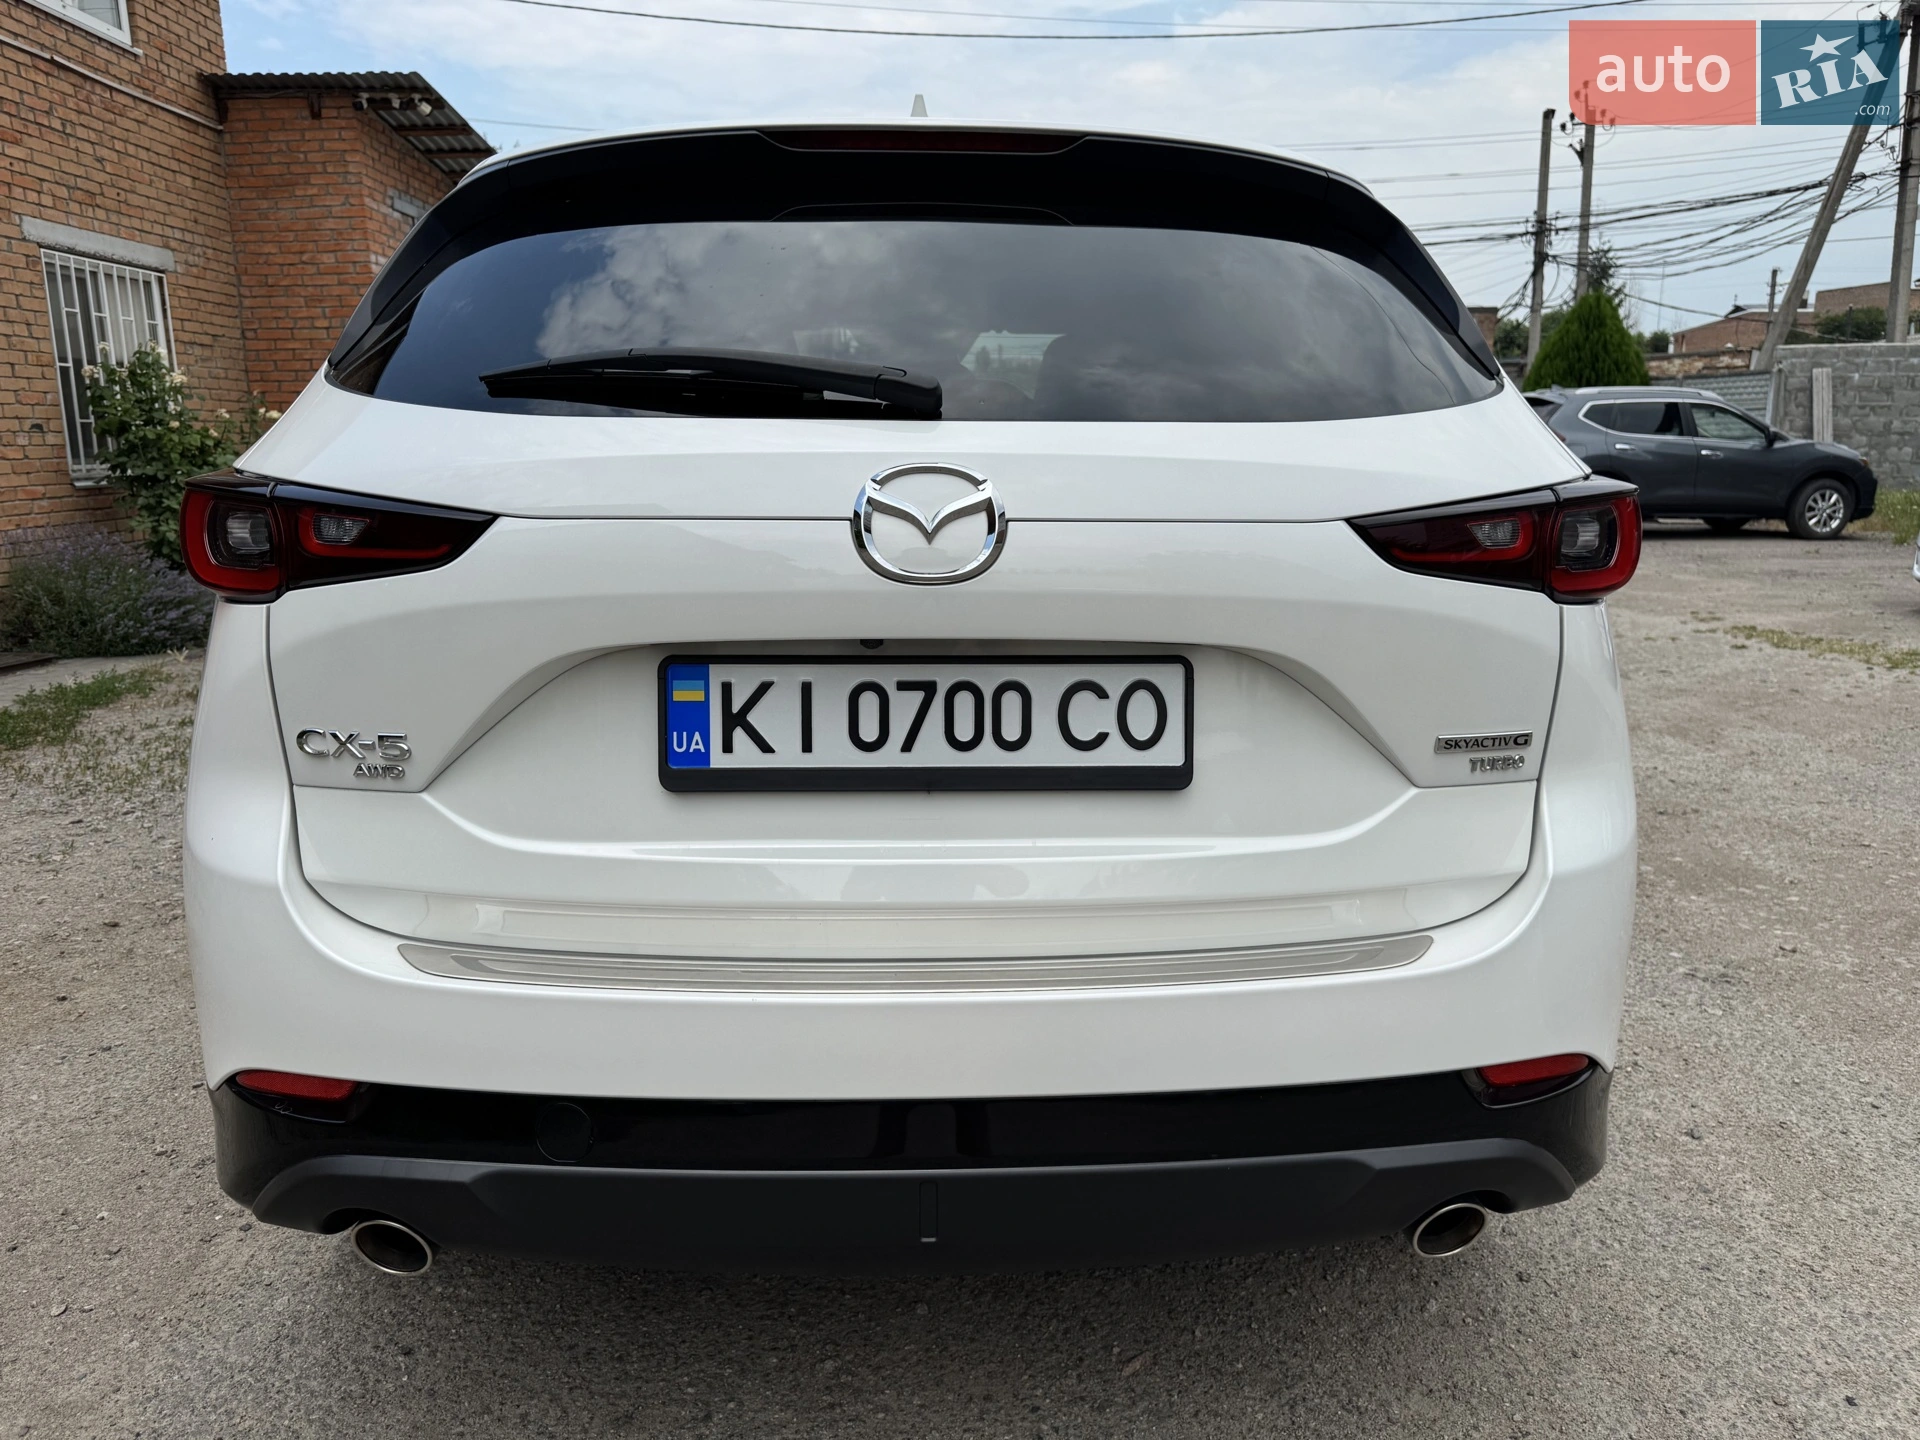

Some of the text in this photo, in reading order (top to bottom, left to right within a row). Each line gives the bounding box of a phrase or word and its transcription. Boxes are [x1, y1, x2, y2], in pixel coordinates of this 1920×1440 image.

[721, 678, 1168, 753] KI 0700 CO
[296, 727, 412, 761] CX-5
[672, 731, 706, 753] UA
[353, 762, 406, 779] AWD
[1469, 754, 1525, 773] TURBO
